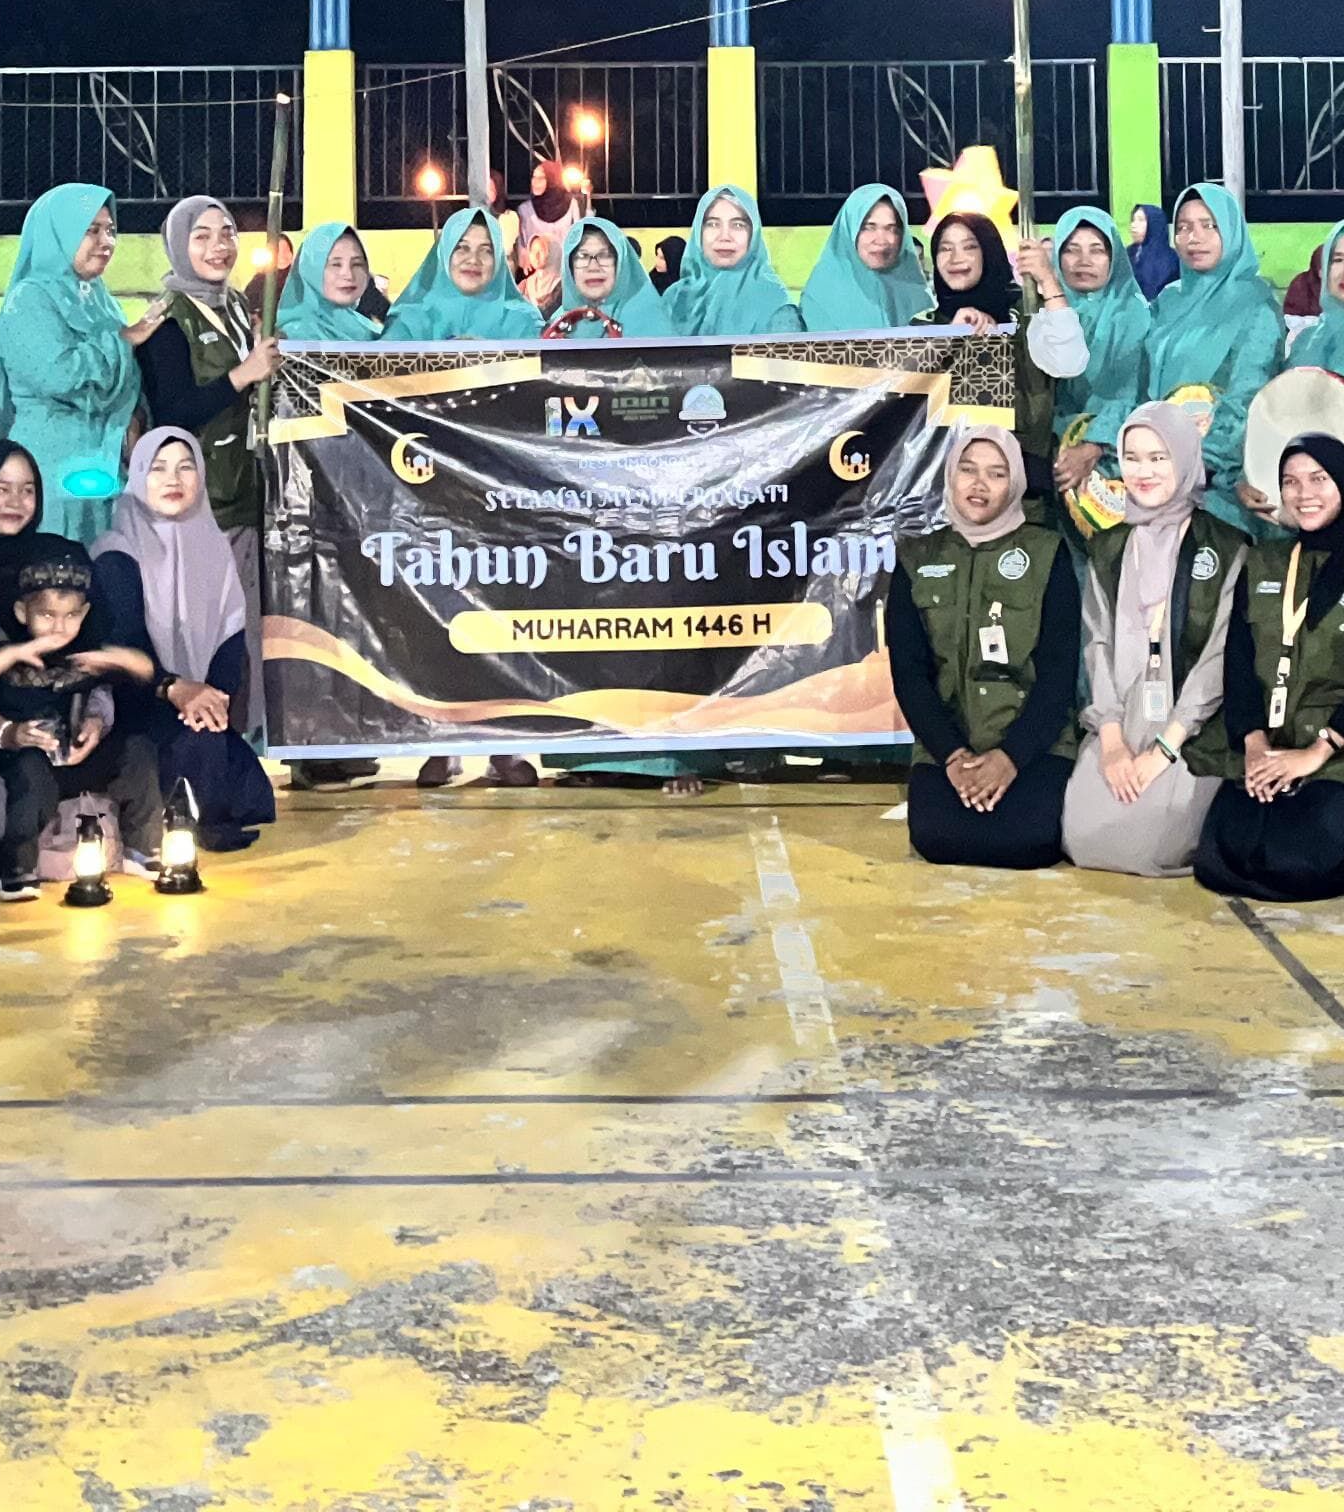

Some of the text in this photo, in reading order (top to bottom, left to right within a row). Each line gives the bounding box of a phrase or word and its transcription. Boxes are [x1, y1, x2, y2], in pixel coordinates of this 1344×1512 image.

[360, 521, 897, 590] Tahun Baru Islam
[512, 613, 772, 641] MUHARRAM 1446 H
